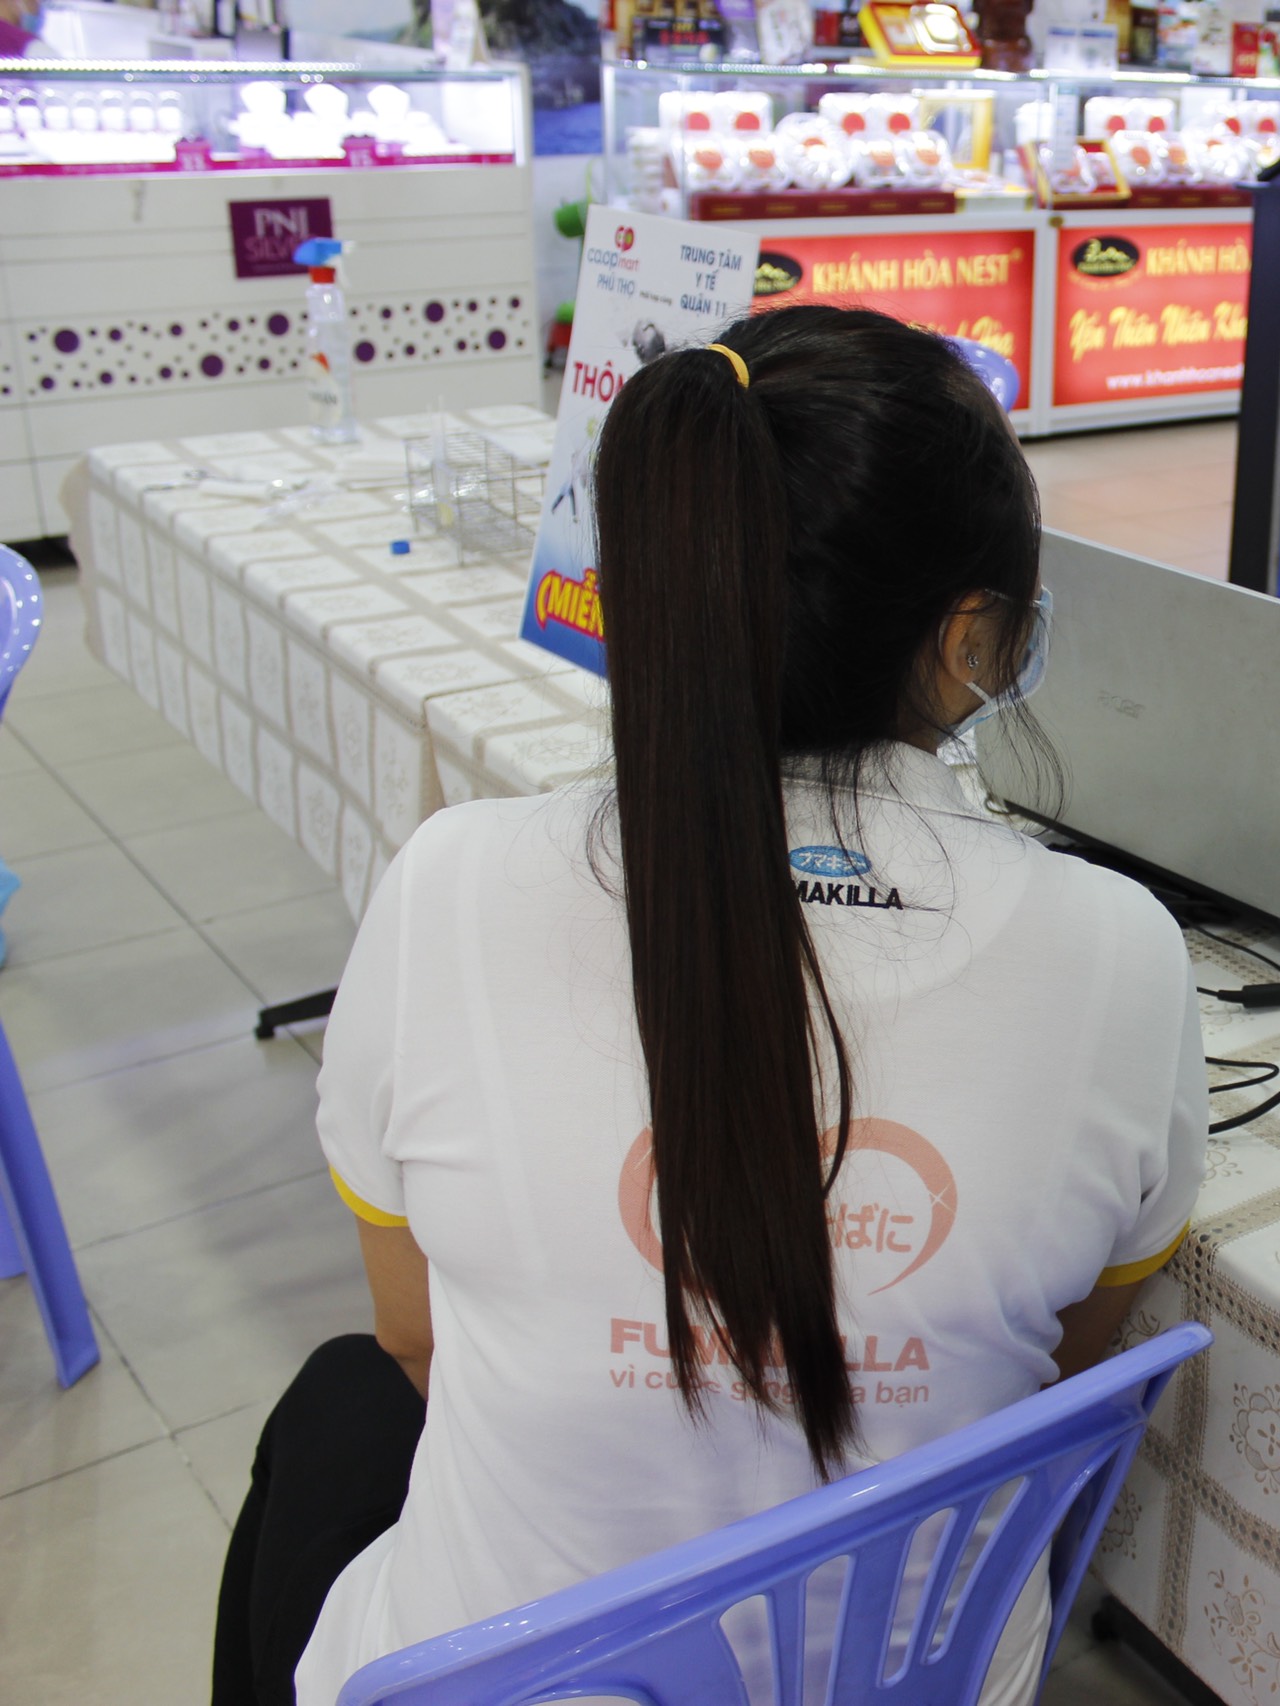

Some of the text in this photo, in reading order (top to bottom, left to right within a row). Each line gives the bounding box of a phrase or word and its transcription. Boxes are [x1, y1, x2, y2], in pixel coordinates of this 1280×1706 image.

[681, 245, 742, 271] TRUNG TÂM
[812, 251, 899, 294] KHÁNH
[903, 249, 953, 291] HÒA
[1145, 239, 1217, 276] KHÁNH
[1218, 237, 1252, 274] HÒ
[597, 273, 615, 291] PHÚ
[696, 270, 718, 291] Y TẾ
[680, 294, 727, 318] QUẬN 11
[825, 1199, 914, 1253] ばに
[610, 1364, 635, 1389] vì
[645, 1370, 721, 1395] cuc
[875, 1380, 929, 1408] bạn
